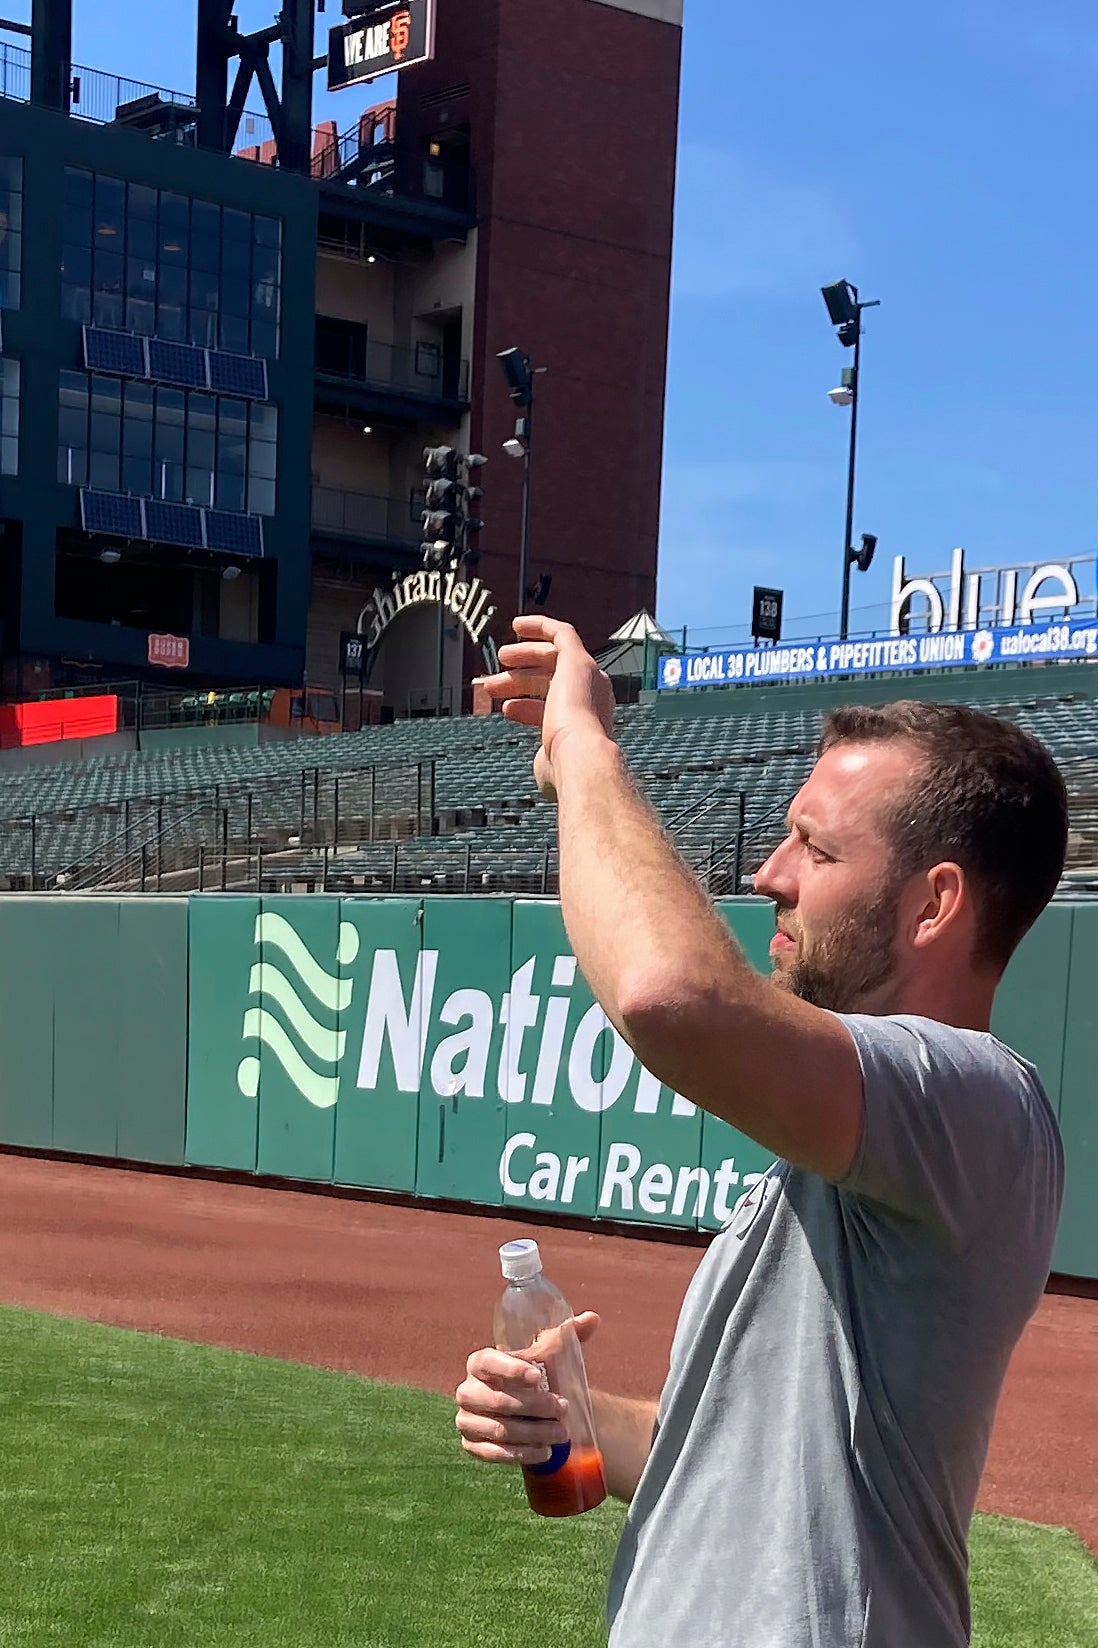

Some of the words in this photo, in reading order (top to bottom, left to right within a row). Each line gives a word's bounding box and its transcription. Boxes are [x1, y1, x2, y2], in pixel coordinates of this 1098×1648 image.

[344, 30, 365, 67] WE
[365, 20, 391, 60] ARE
[760, 600, 778, 618] 138
[891, 548, 1078, 637] blue
[346, 642, 363, 658] 137
[687, 655, 726, 682] LOCAL
[745, 646, 815, 677] PLUMBERS
[816, 645, 828, 671] &
[829, 637, 918, 670] PIPEFITTERS
[919, 634, 965, 662] UNION
[1001, 625, 1098, 656] ualocal38.org
[357, 949, 723, 1121] Natio
[499, 1132, 590, 1203] Car
